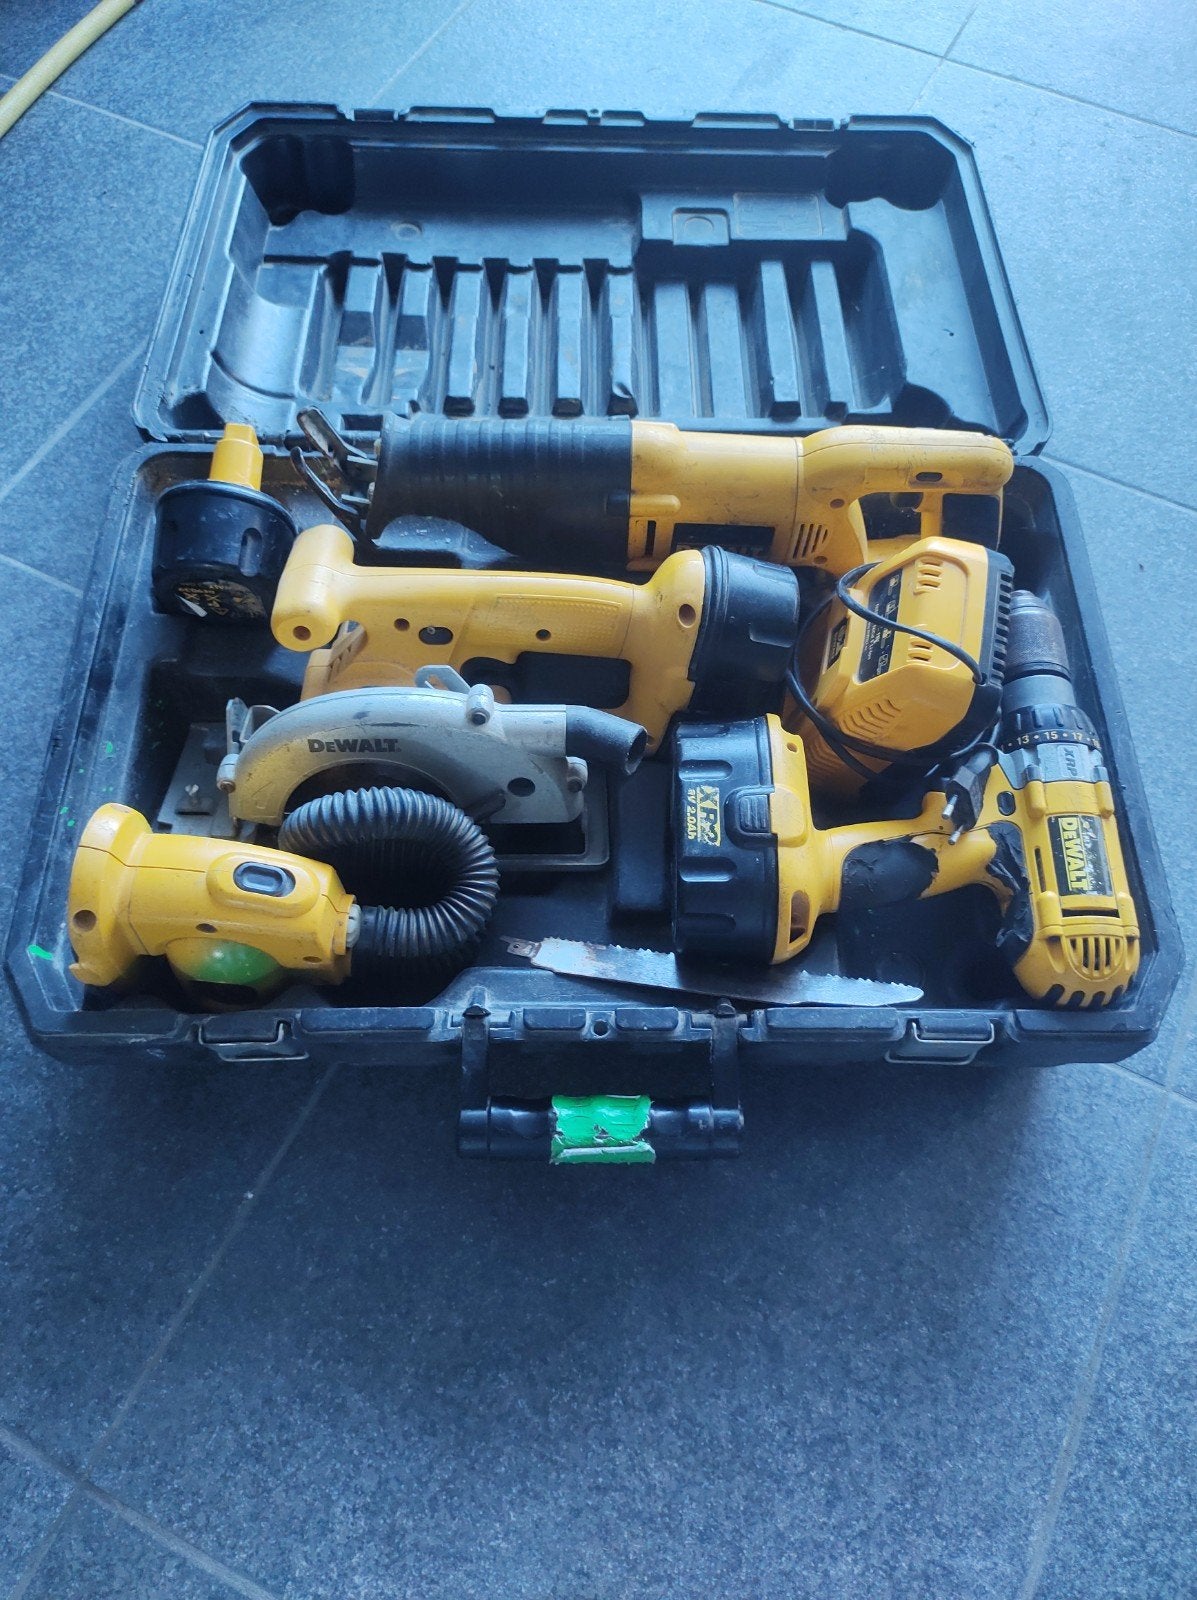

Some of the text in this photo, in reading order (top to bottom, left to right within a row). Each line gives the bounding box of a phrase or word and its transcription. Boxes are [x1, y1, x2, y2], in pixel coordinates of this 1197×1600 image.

[307, 738, 399, 753] DEWALT
[1017, 734, 1030, 745] 13
[1044, 731, 1058, 740] 15
[1072, 732, 1083, 741] 17
[1063, 747, 1078, 777] XRP
[686, 805, 697, 840] 2.0Ah
[1060, 816, 1088, 891] DEWALT
